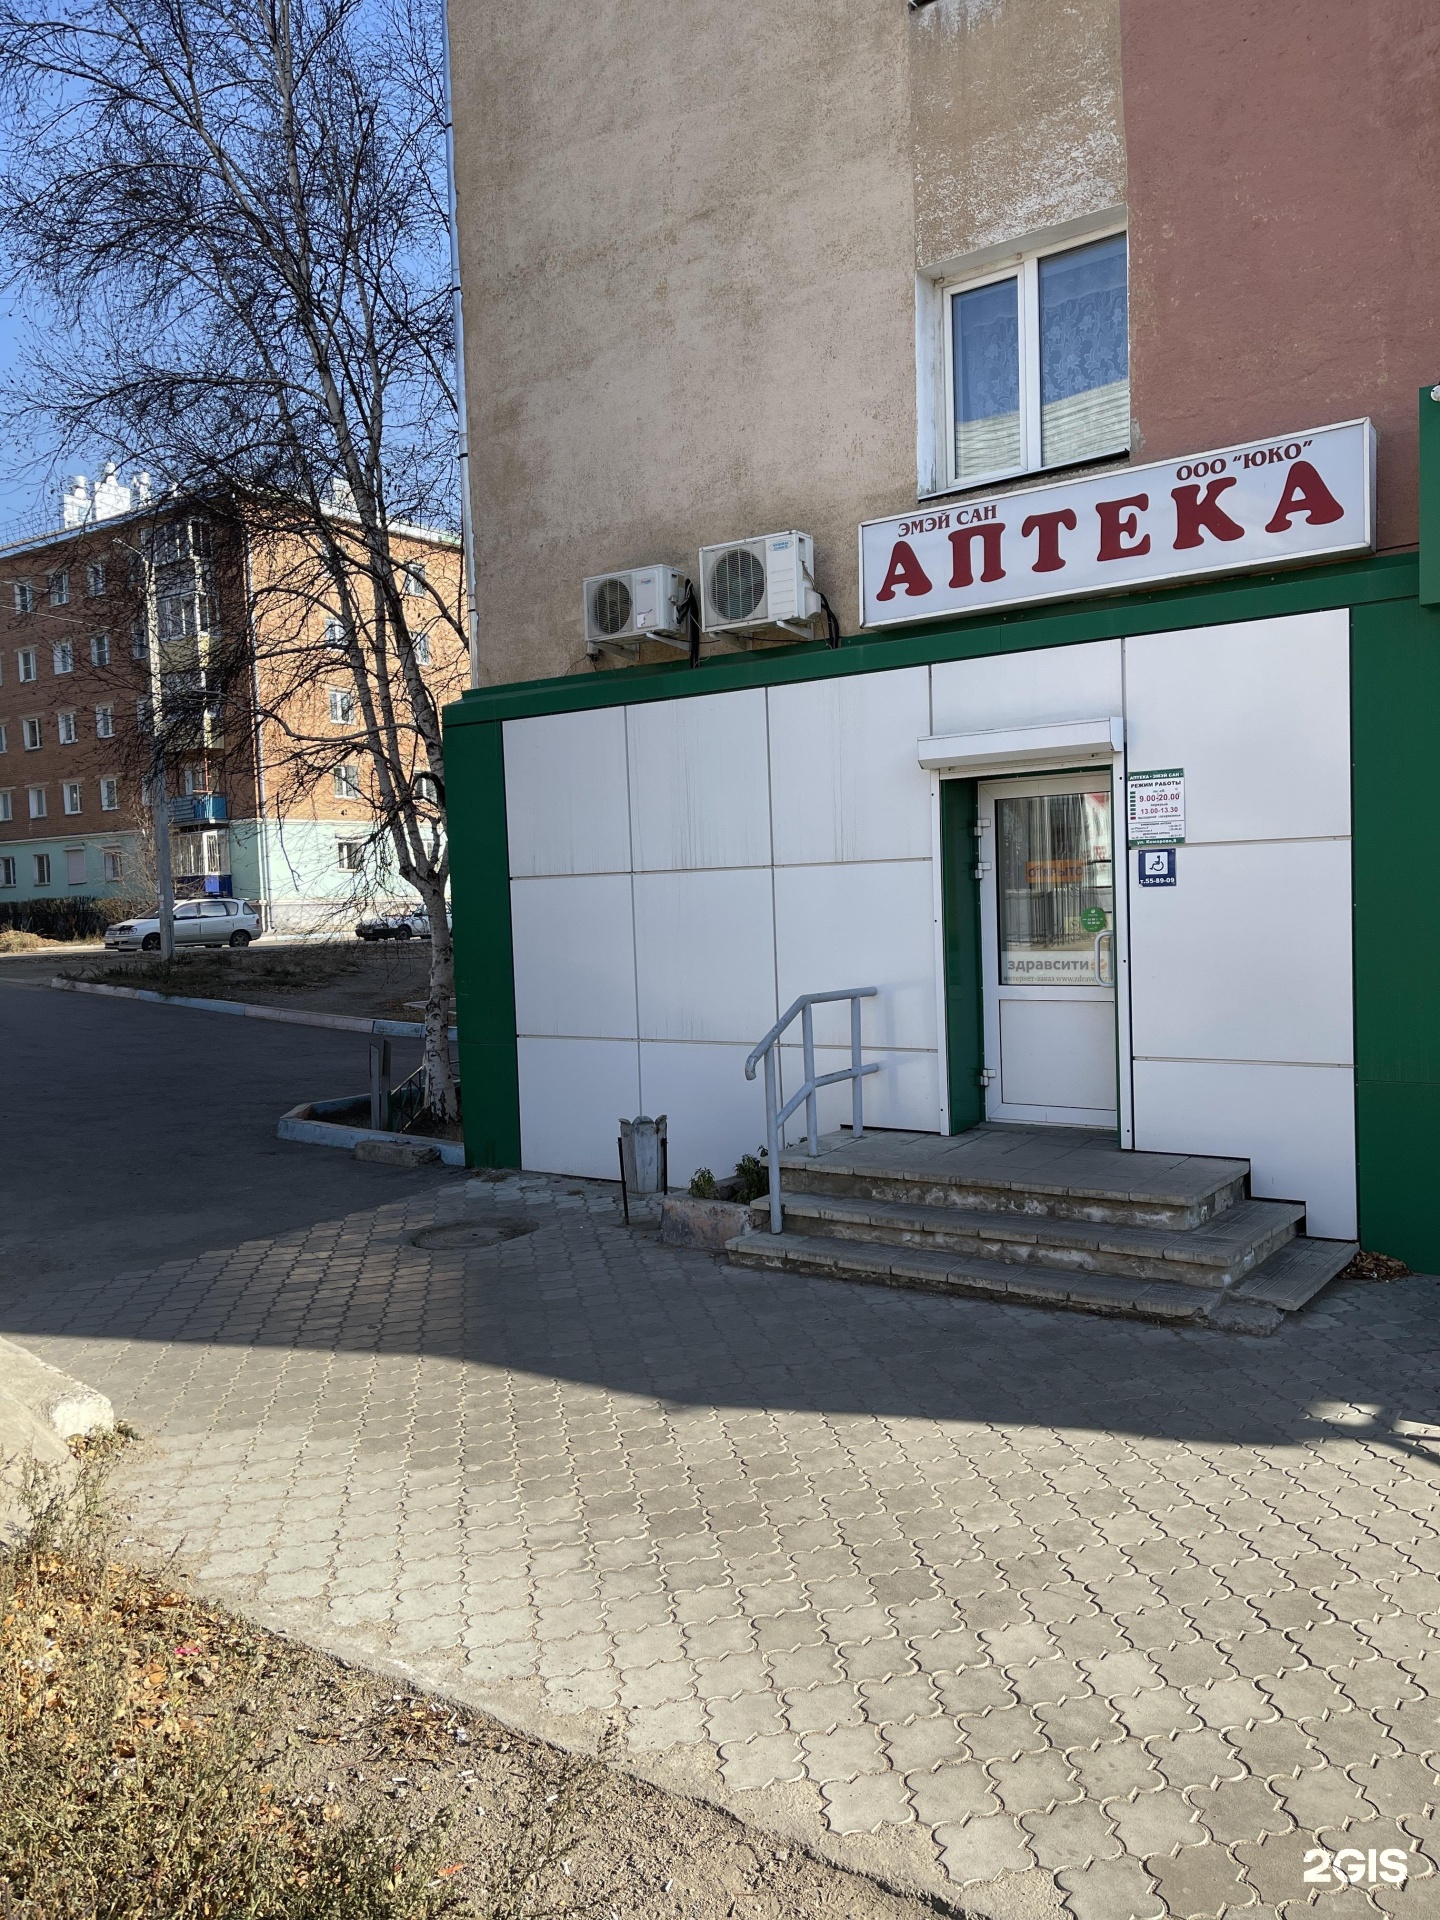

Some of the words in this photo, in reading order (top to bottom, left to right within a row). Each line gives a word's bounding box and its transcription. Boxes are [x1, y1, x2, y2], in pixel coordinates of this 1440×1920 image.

[1176, 458, 1227, 481] ООО
[897, 512, 951, 538] ЭМЭЙ
[956, 504, 997, 526] САН
[876, 460, 1345, 602] АПТЕКА
[1139, 793, 1180, 802] 9.00-20.00
[1141, 806, 1179, 814] 13.00-13.30
[1029, 866, 1083, 877] ОТКРЫТО
[1007, 959, 1089, 973] здравсити
